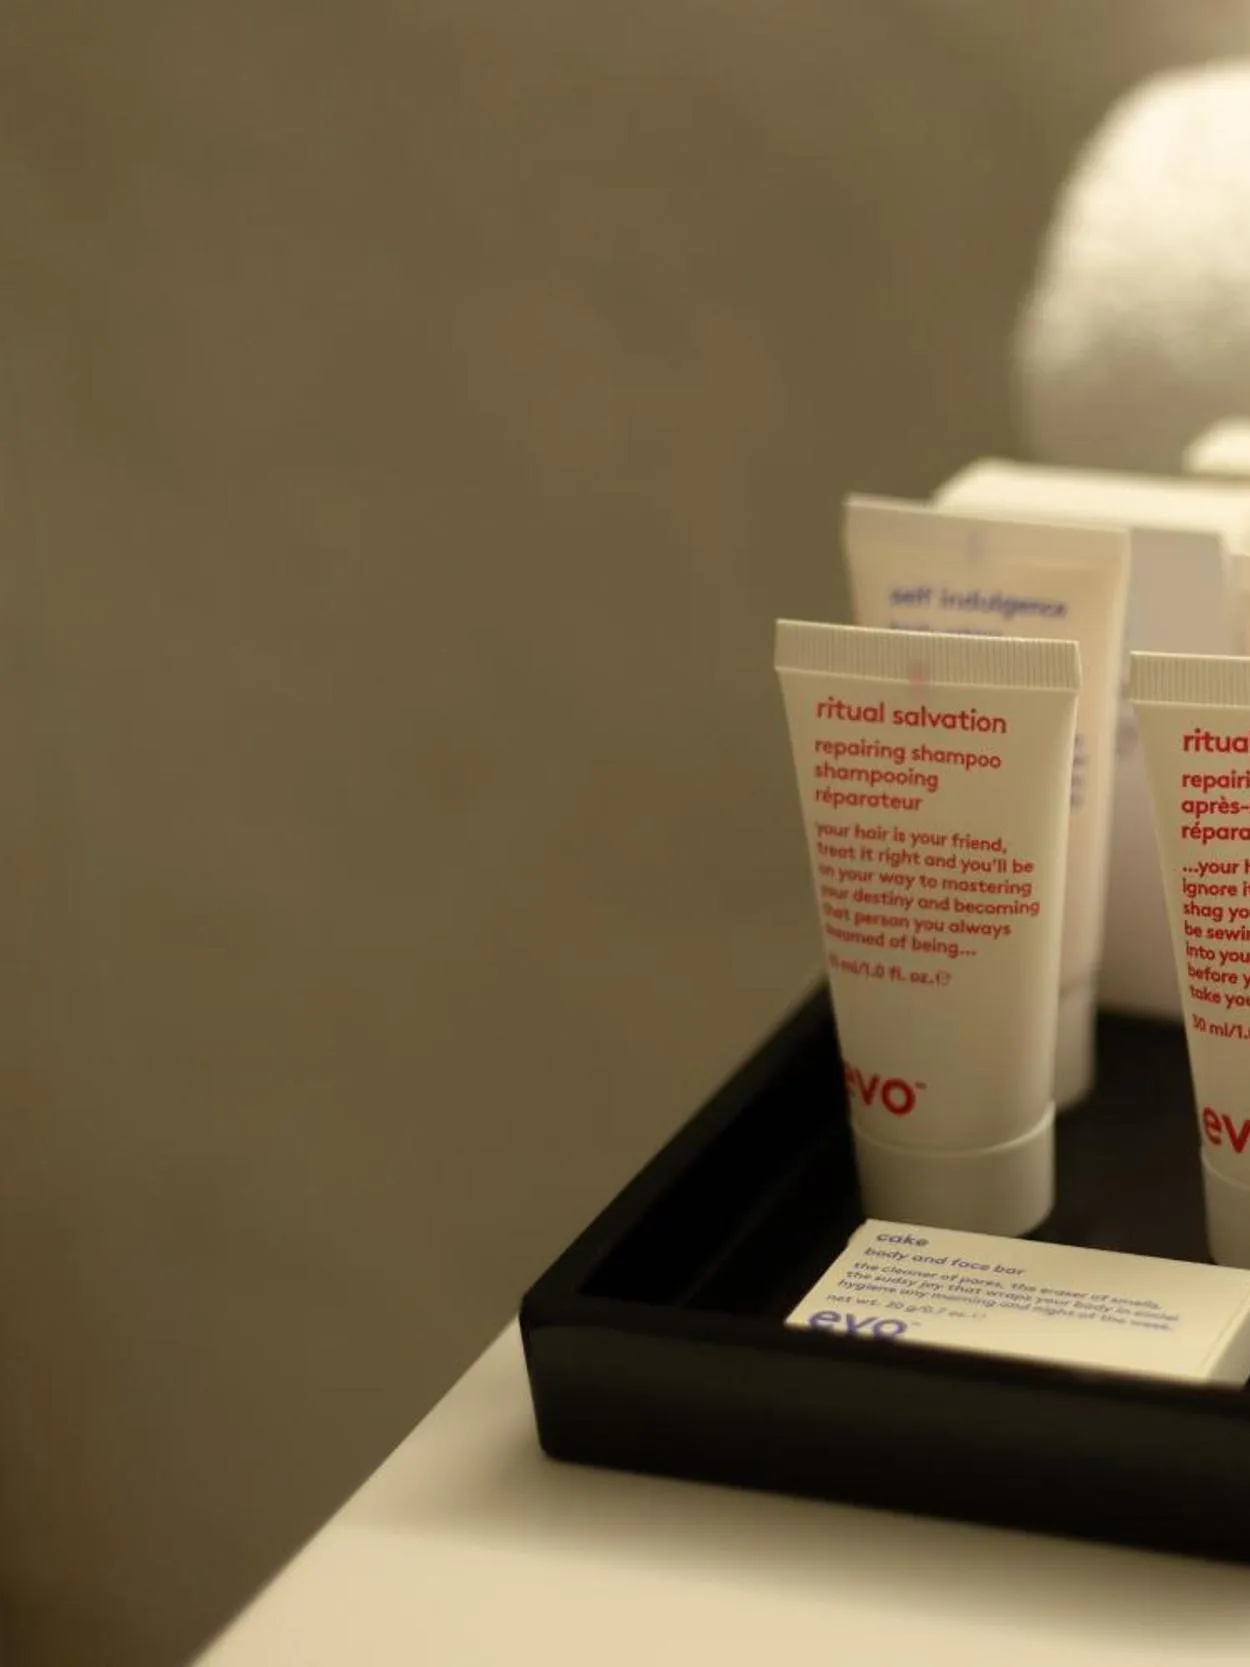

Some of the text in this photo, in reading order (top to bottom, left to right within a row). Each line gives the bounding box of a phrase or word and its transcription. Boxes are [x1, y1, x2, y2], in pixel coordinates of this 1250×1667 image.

[816, 696, 1007, 734] ritual salvation
[815, 738, 1001, 770] repairing shampoo
[815, 763, 939, 792] shampooing
[816, 787, 923, 811] réparateur
[816, 821, 1007, 854] your hair is your friend,
[817, 842, 1033, 873] treat it right and you'll be
[1183, 860, 1239, 880] ...your
[838, 866, 874, 883] your
[879, 872, 915, 889] way
[920, 876, 937, 889] to
[942, 877, 1032, 896] mastering
[1183, 878, 1237, 897] ignore
[853, 888, 914, 910] destiny
[918, 894, 949, 910] and
[954, 899, 1040, 917] becoming
[1183, 902, 1223, 922] shag
[855, 911, 909, 928] person
[915, 919, 944, 935] you
[949, 918, 1011, 939] always
[1184, 920, 1202, 936] be
[890, 934, 907, 948] of
[912, 934, 976, 958] being...
[1186, 943, 1215, 960] into
[1188, 963, 1237, 984] before
[1190, 985, 1220, 1003] take
[877, 1232, 928, 1247] cake
[864, 1247, 1024, 1275] body and face bar
[846, 1270, 871, 1280] the
[874, 1274, 919, 1287] sudsy
[921, 1280, 943, 1290] joy
[948, 1284, 982, 1294] that
[986, 1291, 1032, 1303] wraps
[1036, 1297, 1069, 1307] your
[1074, 1300, 1115, 1313] body
[854, 1261, 879, 1271] the
[883, 1263, 942, 1278] cleaner
[940, 1272, 959, 1281] of
[1012, 1283, 1036, 1293] the
[1040, 1286, 1089, 1298] eraser
[838, 1279, 897, 1293] hygiene
[900, 1288, 930, 1298] any
[932, 1291, 995, 1308] morning
[999, 1301, 1031, 1310] and
[1032, 1305, 1075, 1316] night
[1101, 1315, 1126, 1324] the
